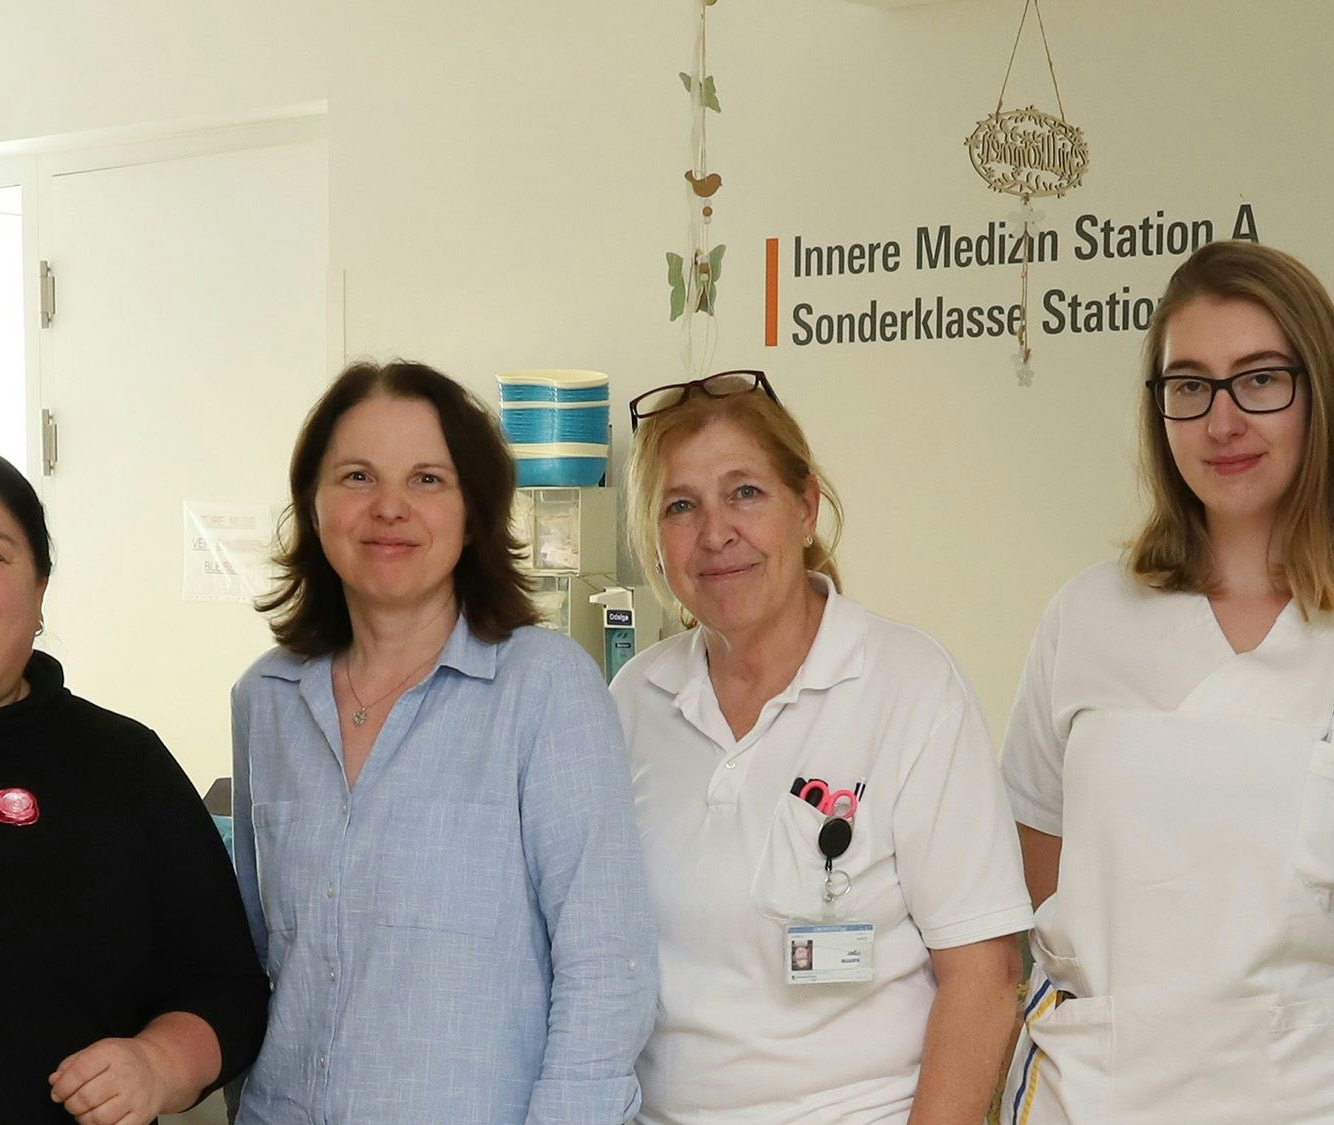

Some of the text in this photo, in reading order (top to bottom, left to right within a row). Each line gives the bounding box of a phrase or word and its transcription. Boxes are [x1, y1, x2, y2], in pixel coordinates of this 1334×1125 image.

[794, 204, 1259, 277] Innere Medizin Station A
[792, 286, 1158, 346] Sonderklasse Statio
